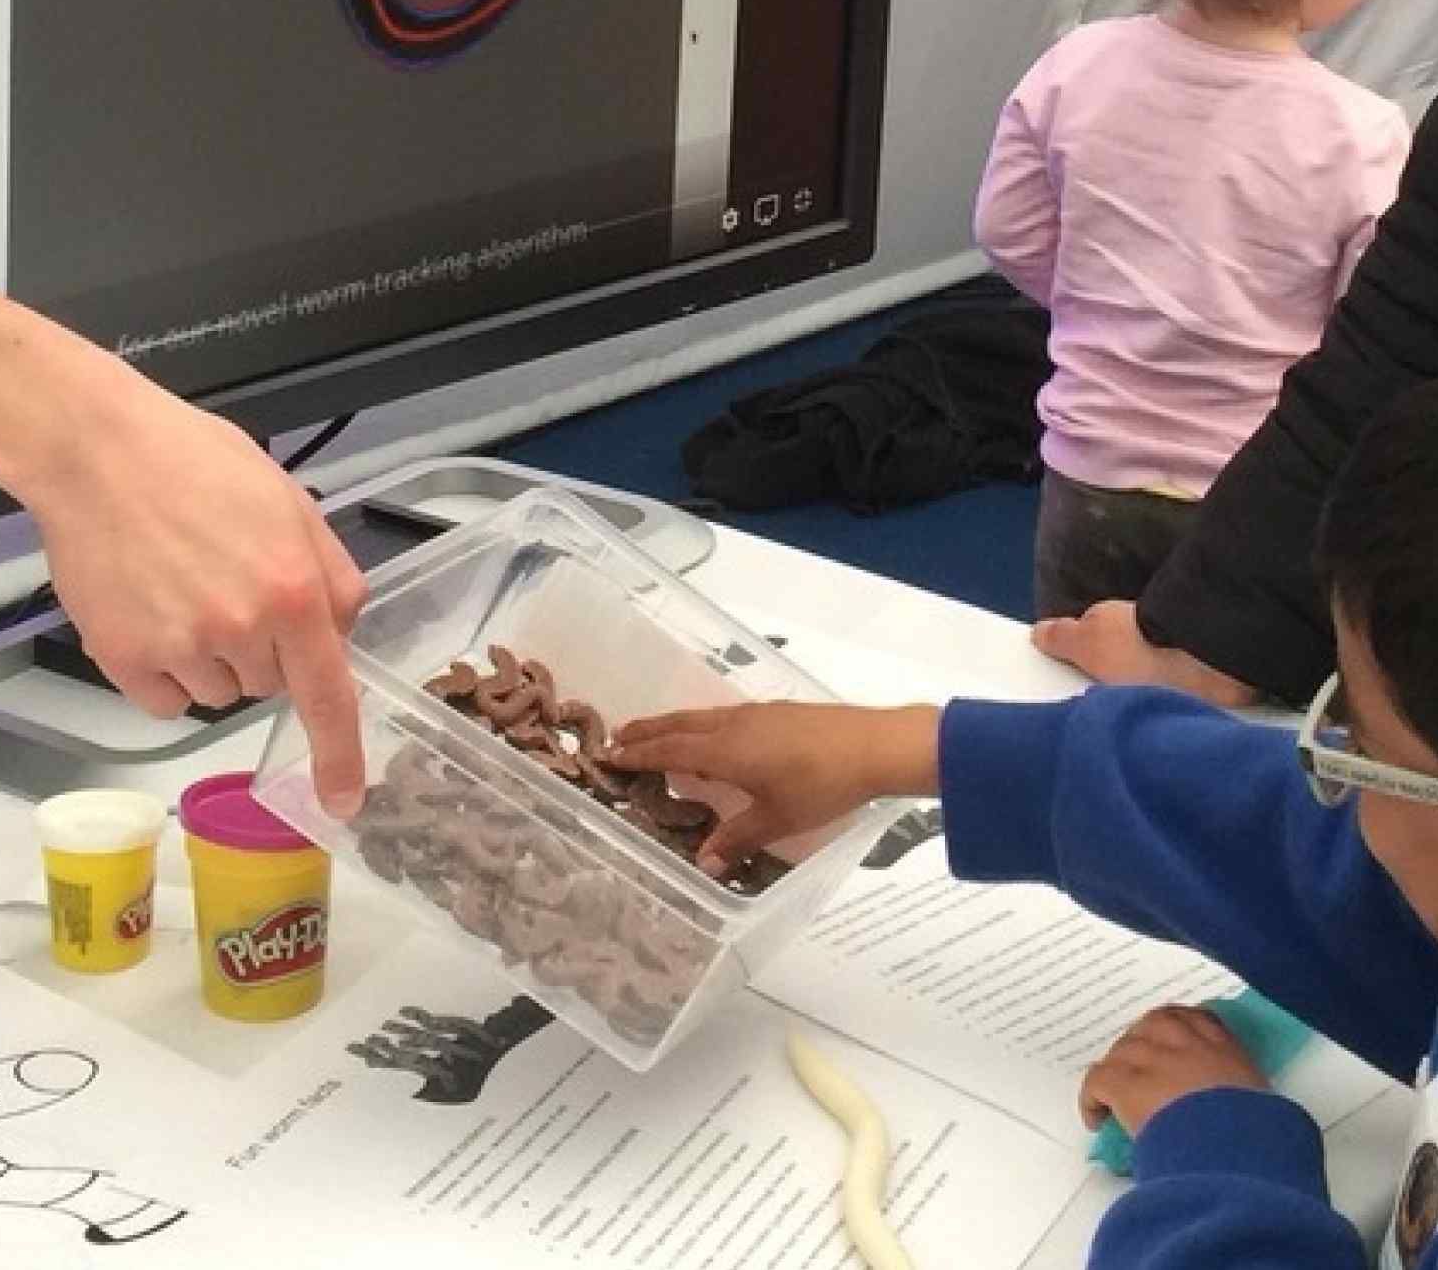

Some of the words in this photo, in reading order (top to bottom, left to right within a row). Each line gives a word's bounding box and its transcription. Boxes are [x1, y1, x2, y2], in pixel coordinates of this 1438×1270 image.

[296, 275, 367, 316] worm
[374, 252, 472, 296] tracking
[477, 221, 589, 270] algorithm
[216, 912, 326, 978] Play-D
